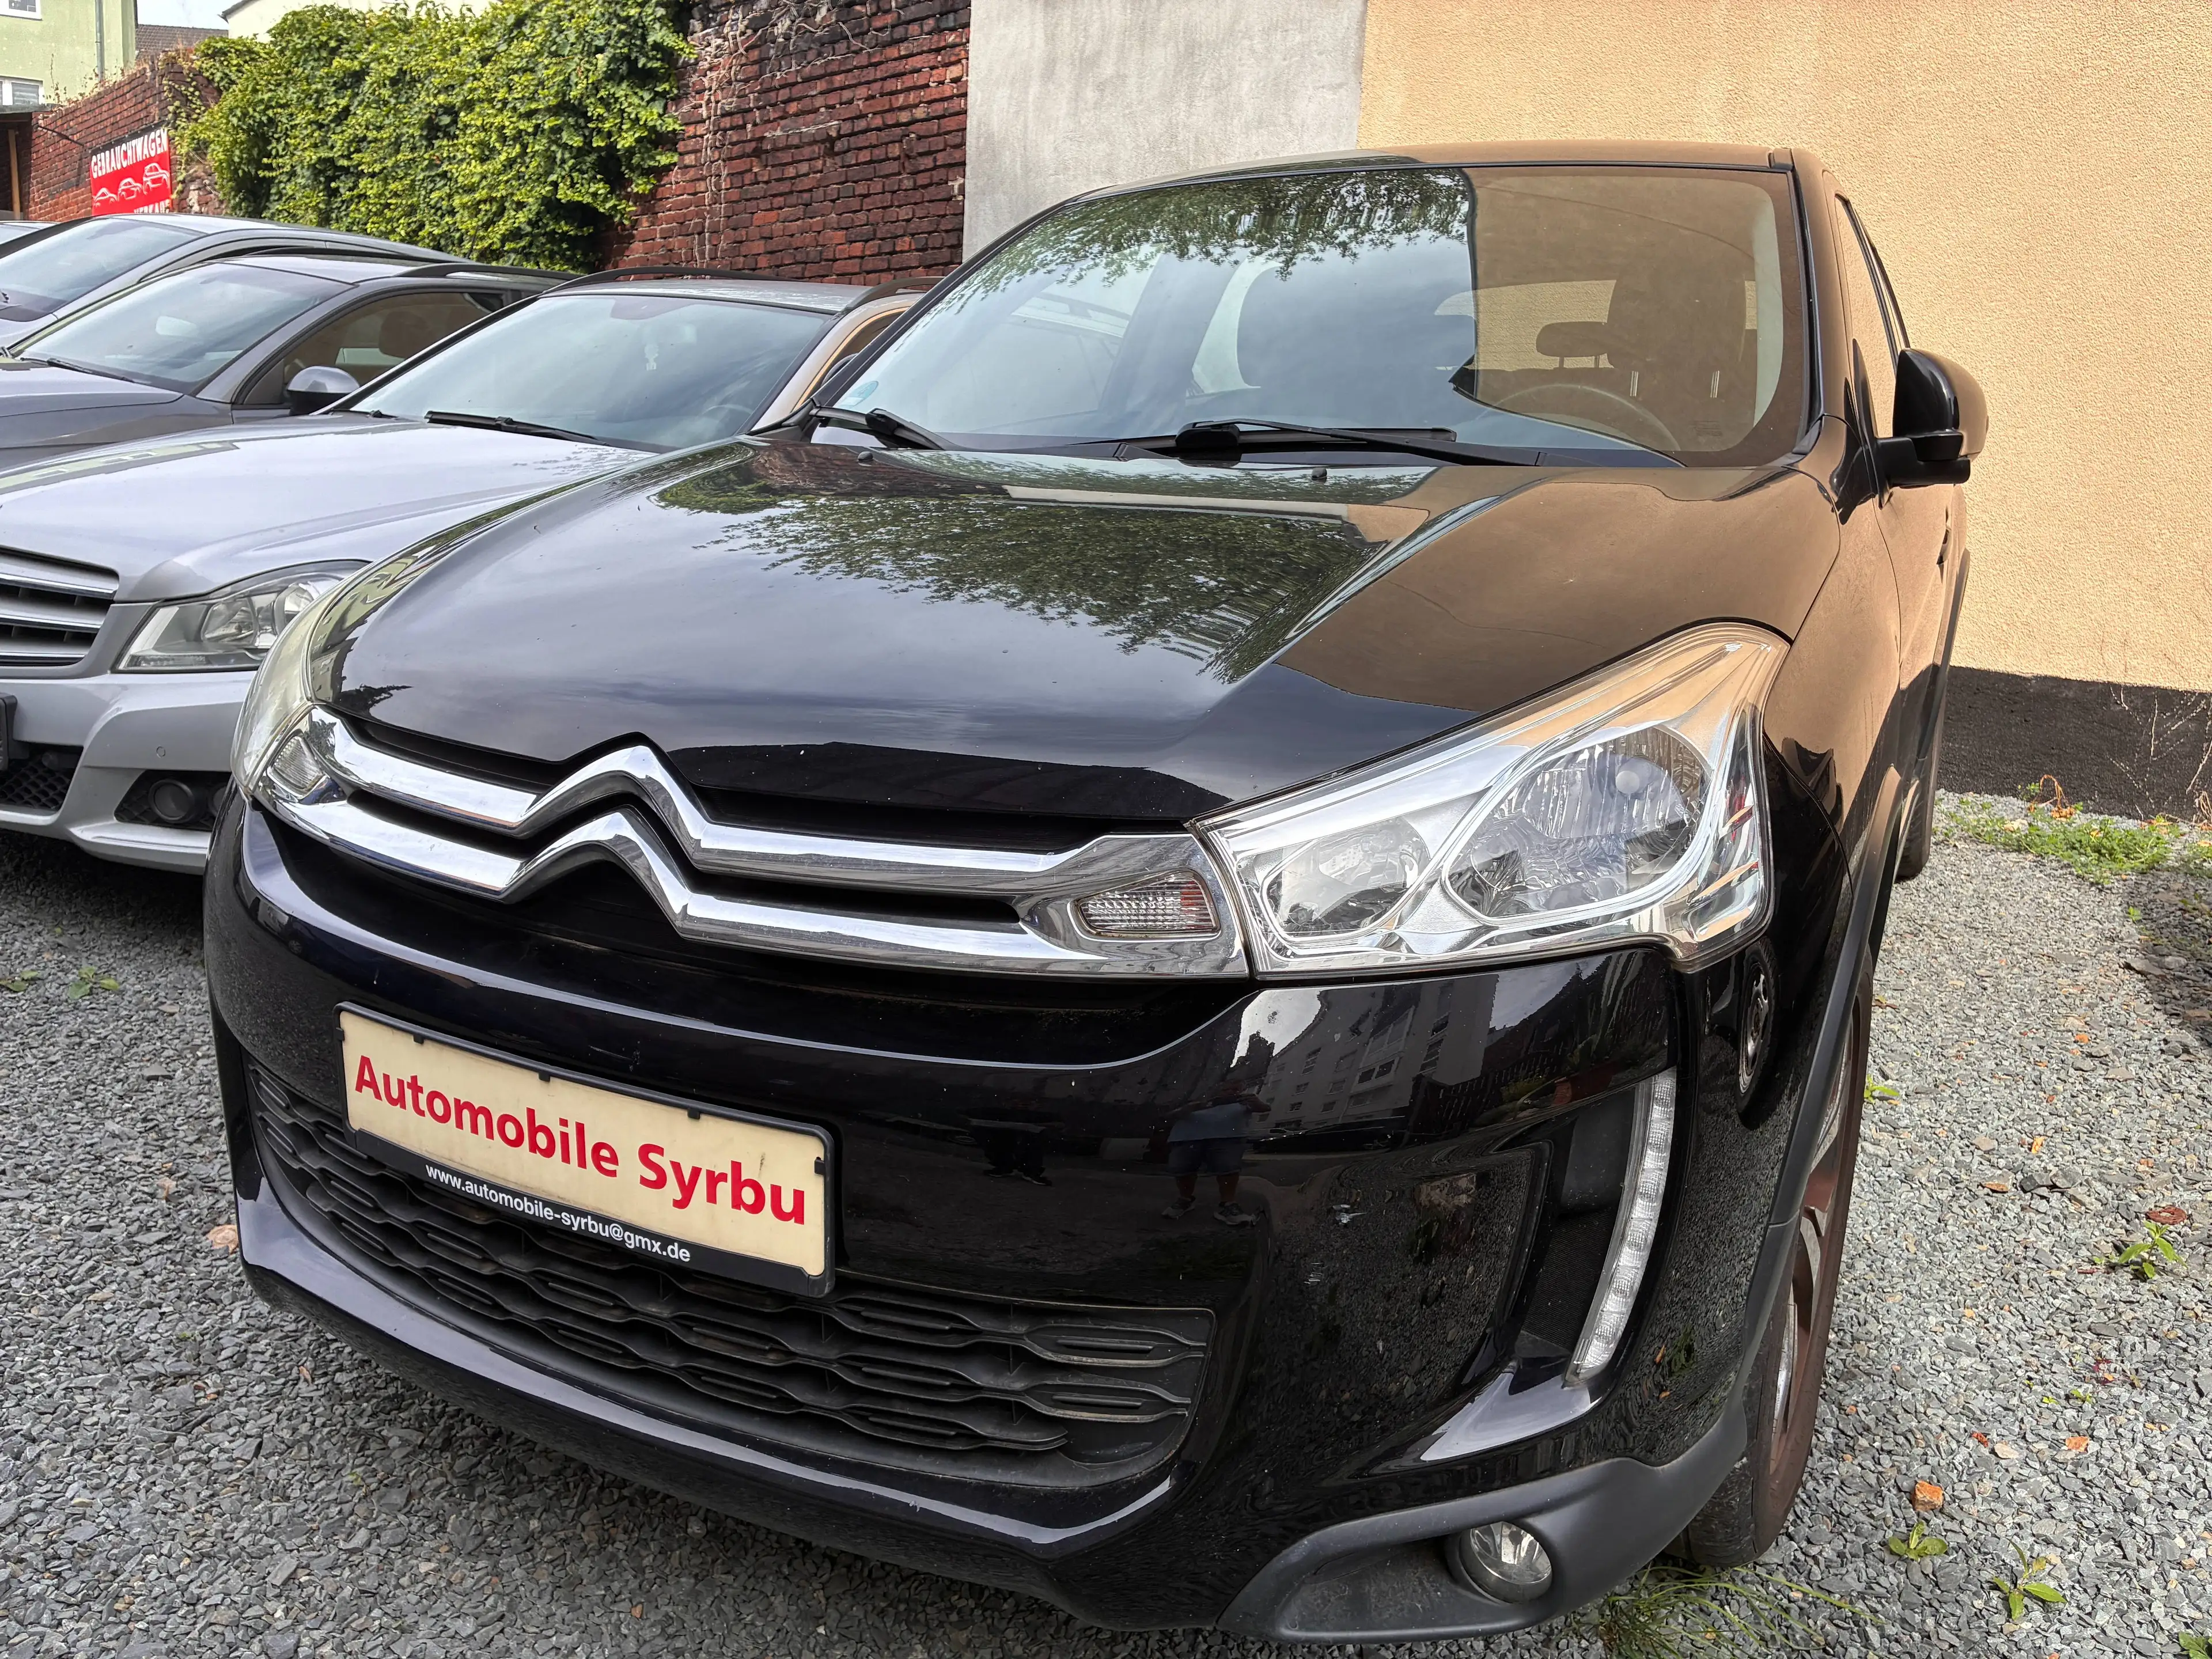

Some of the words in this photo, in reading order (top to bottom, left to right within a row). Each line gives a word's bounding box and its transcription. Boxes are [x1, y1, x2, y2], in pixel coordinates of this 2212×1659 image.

[91, 128, 168, 179] GEBRAUCHTWAGEN
[355, 1056, 619, 1177] Automobile
[638, 1143, 805, 1225] Syrbu
[425, 1164, 691, 1262] www.automobile-syrbu@gmx.de
